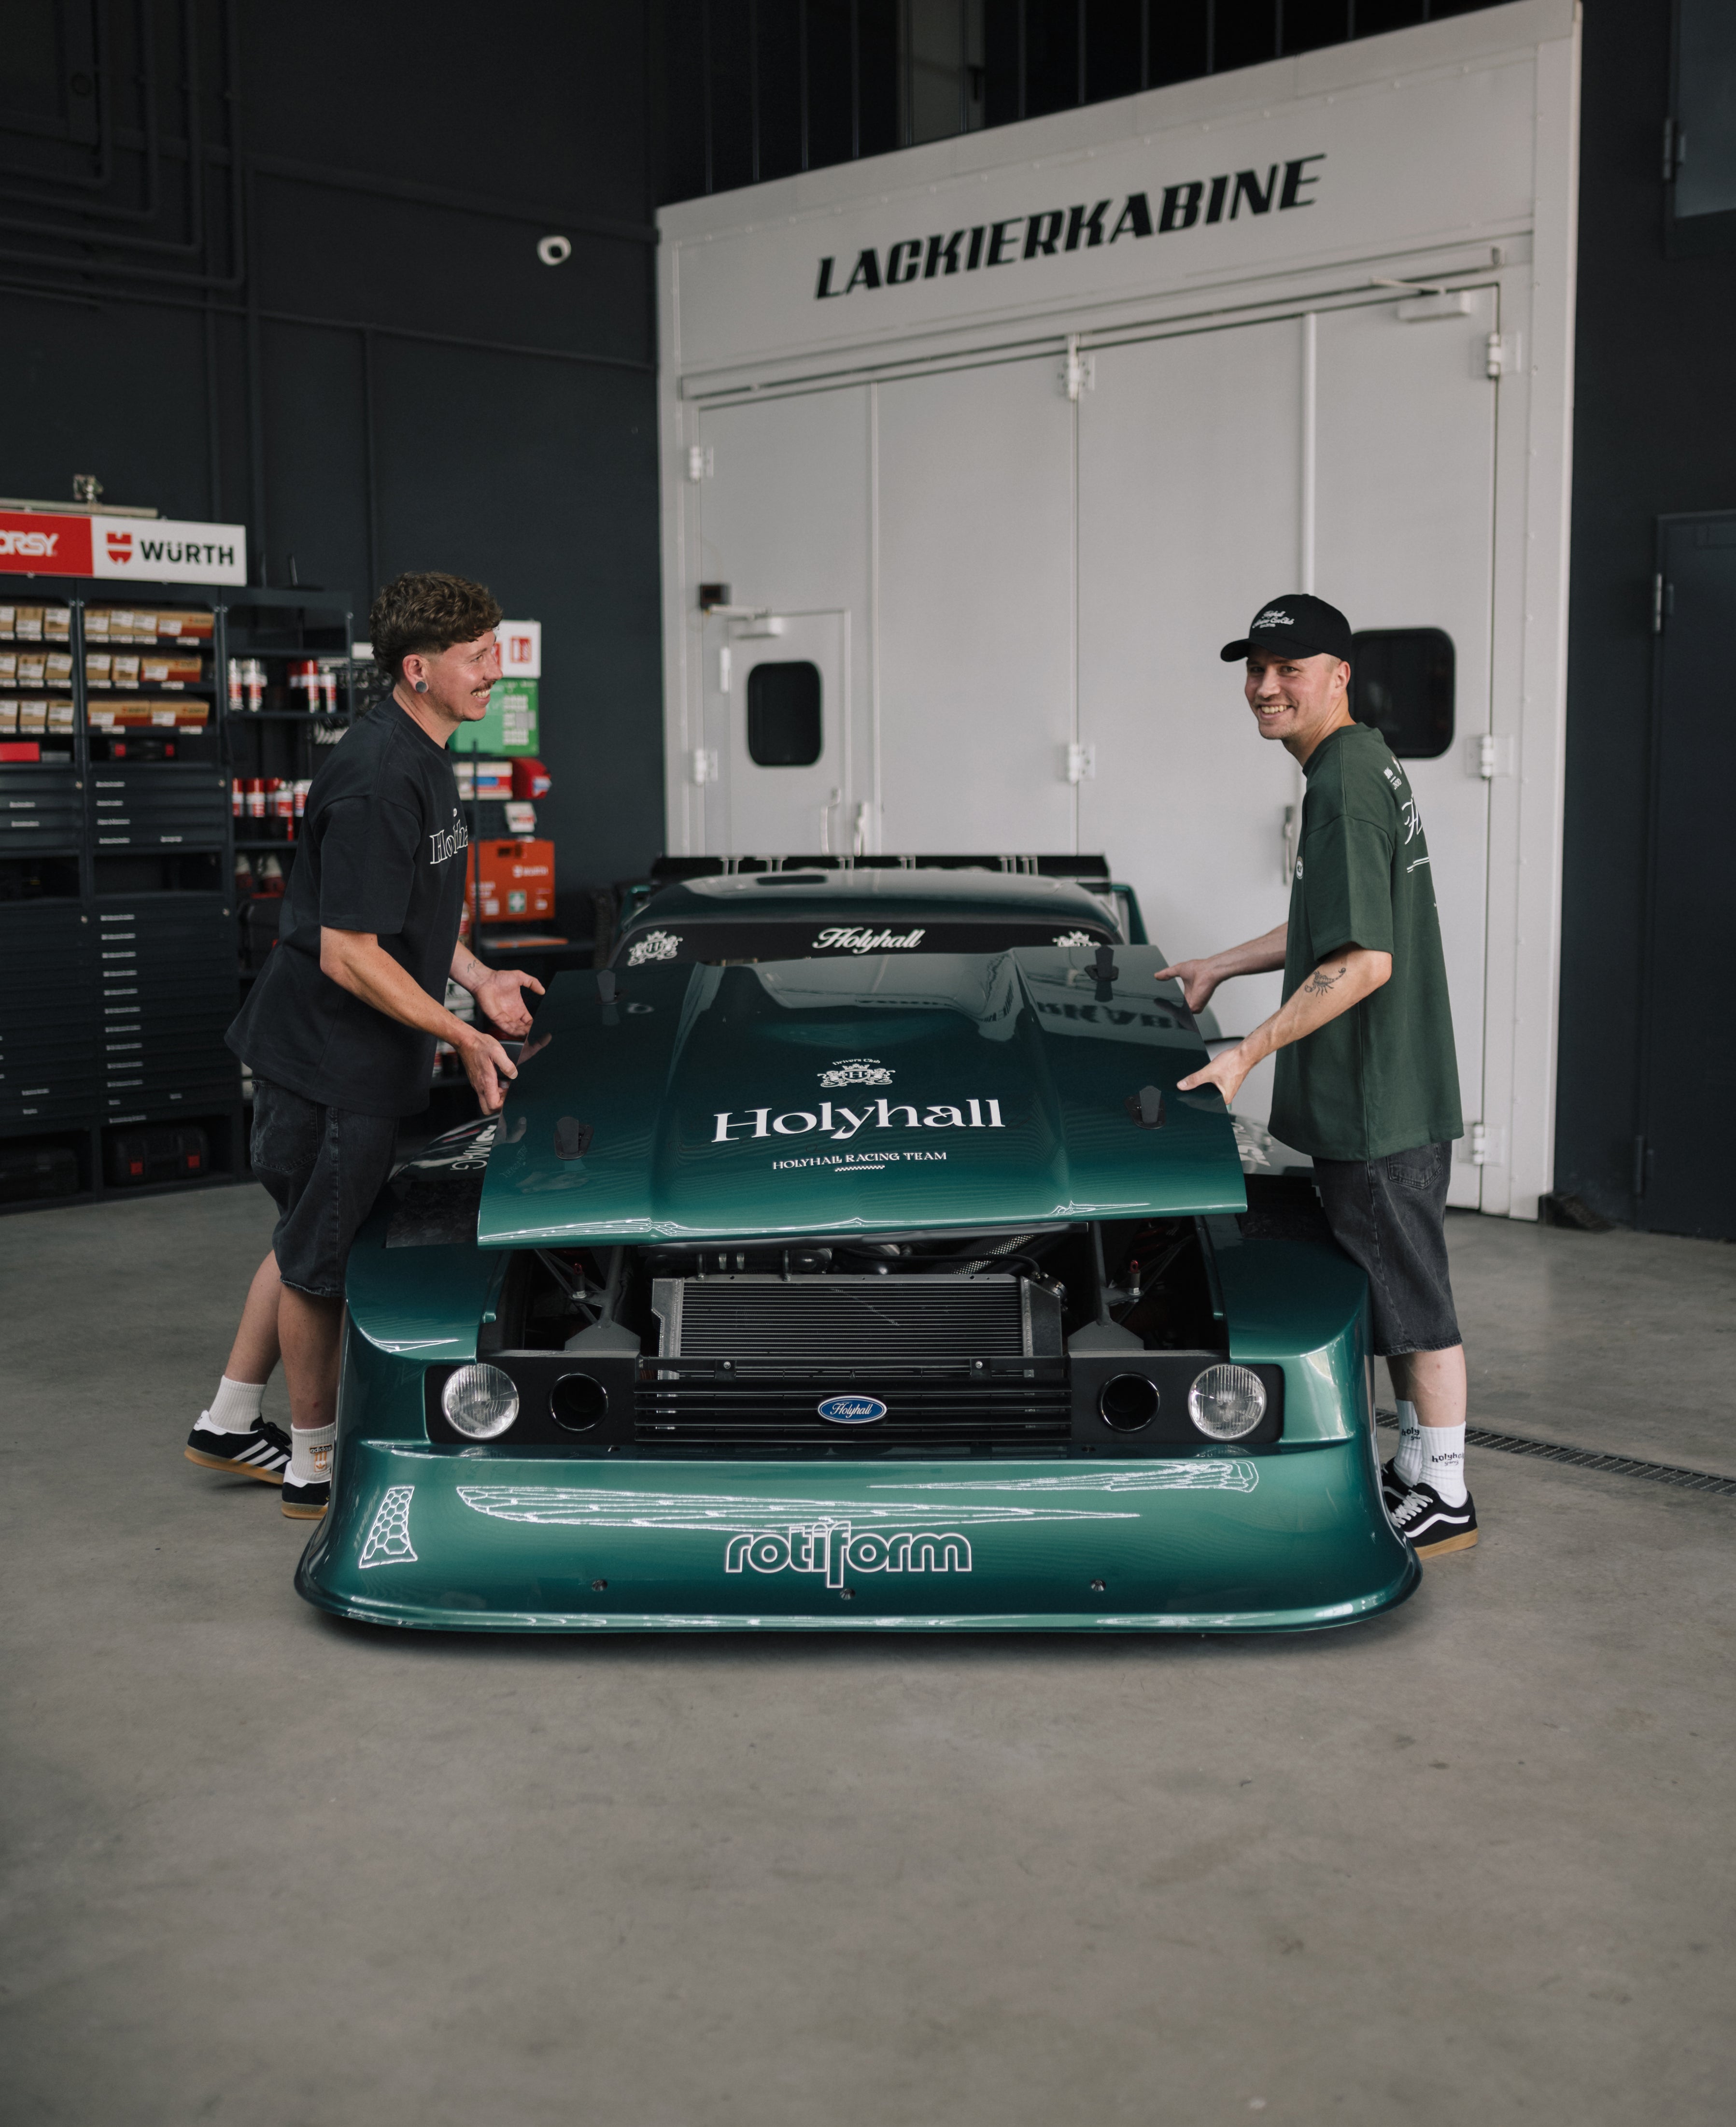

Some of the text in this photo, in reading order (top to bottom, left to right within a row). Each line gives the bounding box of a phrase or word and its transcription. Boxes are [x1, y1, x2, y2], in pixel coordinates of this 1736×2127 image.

[815, 154, 1327, 299] LACKIERKABINE
[140, 539, 234, 567] WÜRTH
[812, 926, 926, 954] Holyhall
[711, 1098, 1006, 1143] Holyhall
[773, 1155, 842, 1169] HOLYHALL
[846, 1153, 900, 1163] RACING
[830, 1402, 873, 1418] Holyhall
[725, 1521, 972, 1588] rotiform
